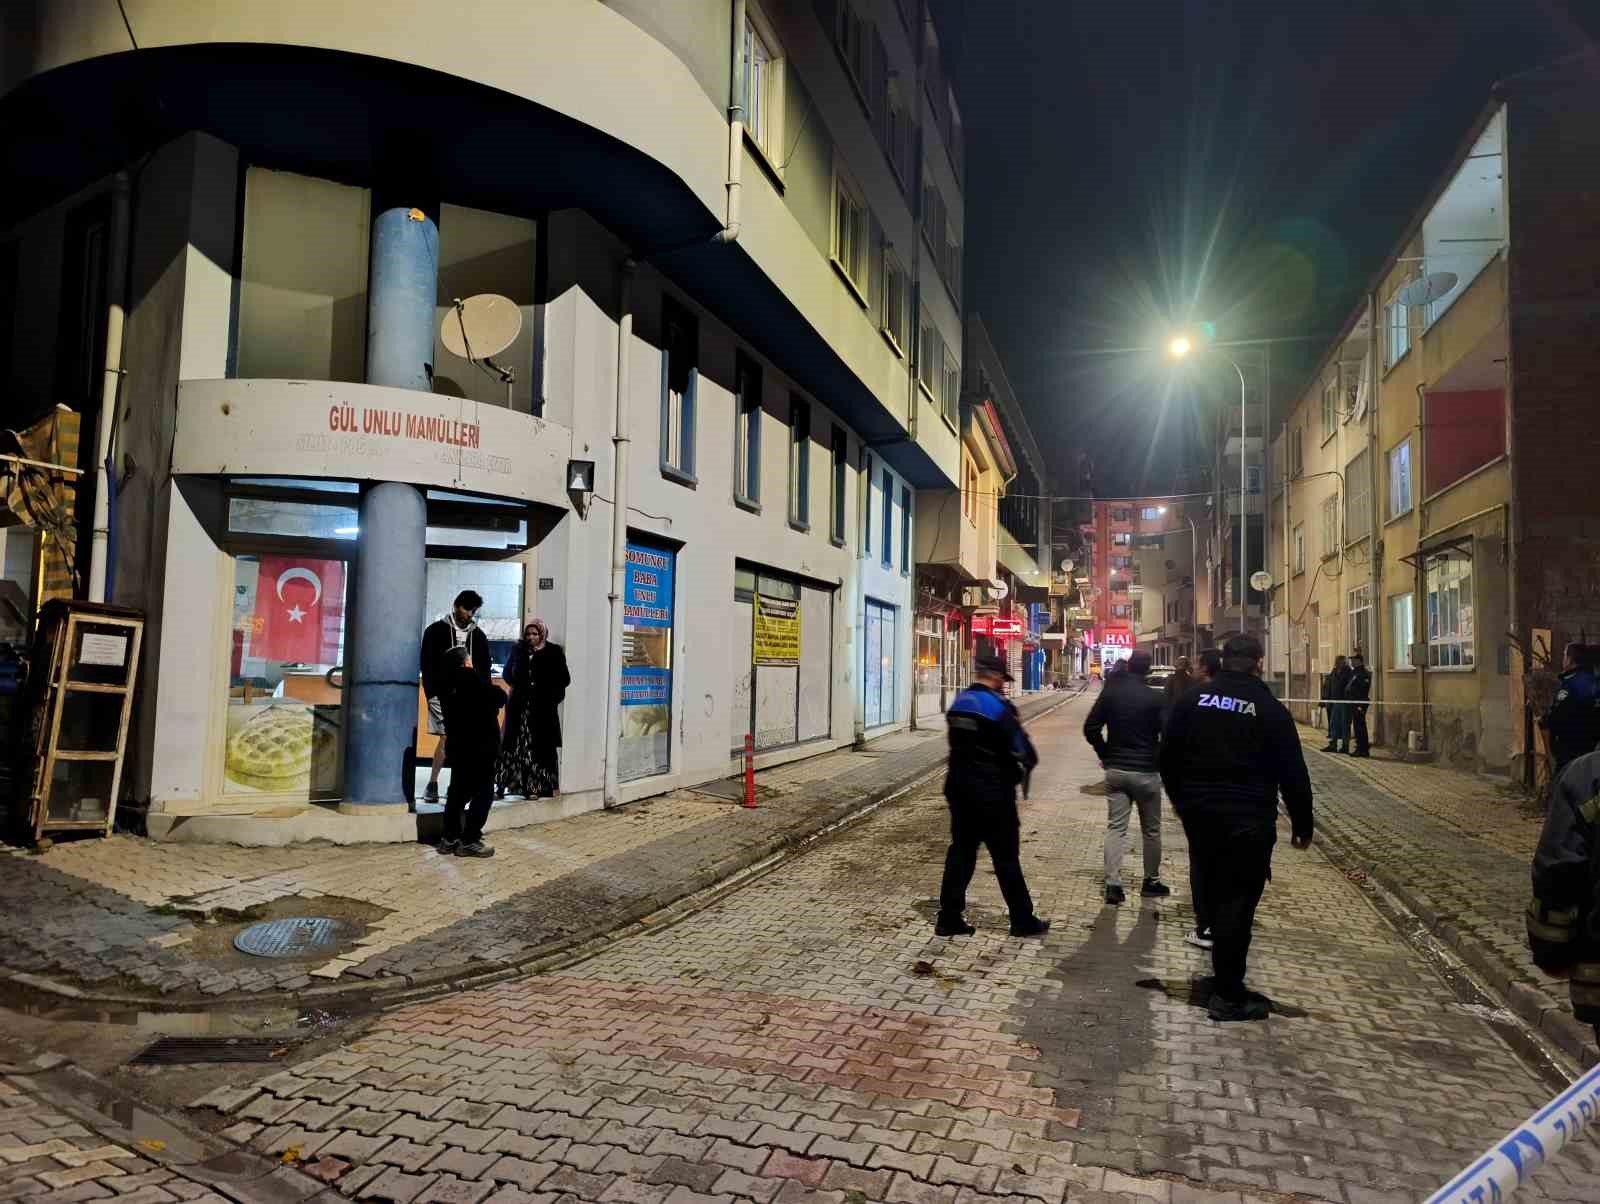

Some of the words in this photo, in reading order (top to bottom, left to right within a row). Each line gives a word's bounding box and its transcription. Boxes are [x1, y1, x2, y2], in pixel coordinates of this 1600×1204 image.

[329, 400, 357, 432] GÜL
[363, 408, 401, 436] UNLU
[406, 413, 480, 448] MAMÜLLERİ
[1198, 694, 1256, 716] ZABITA
